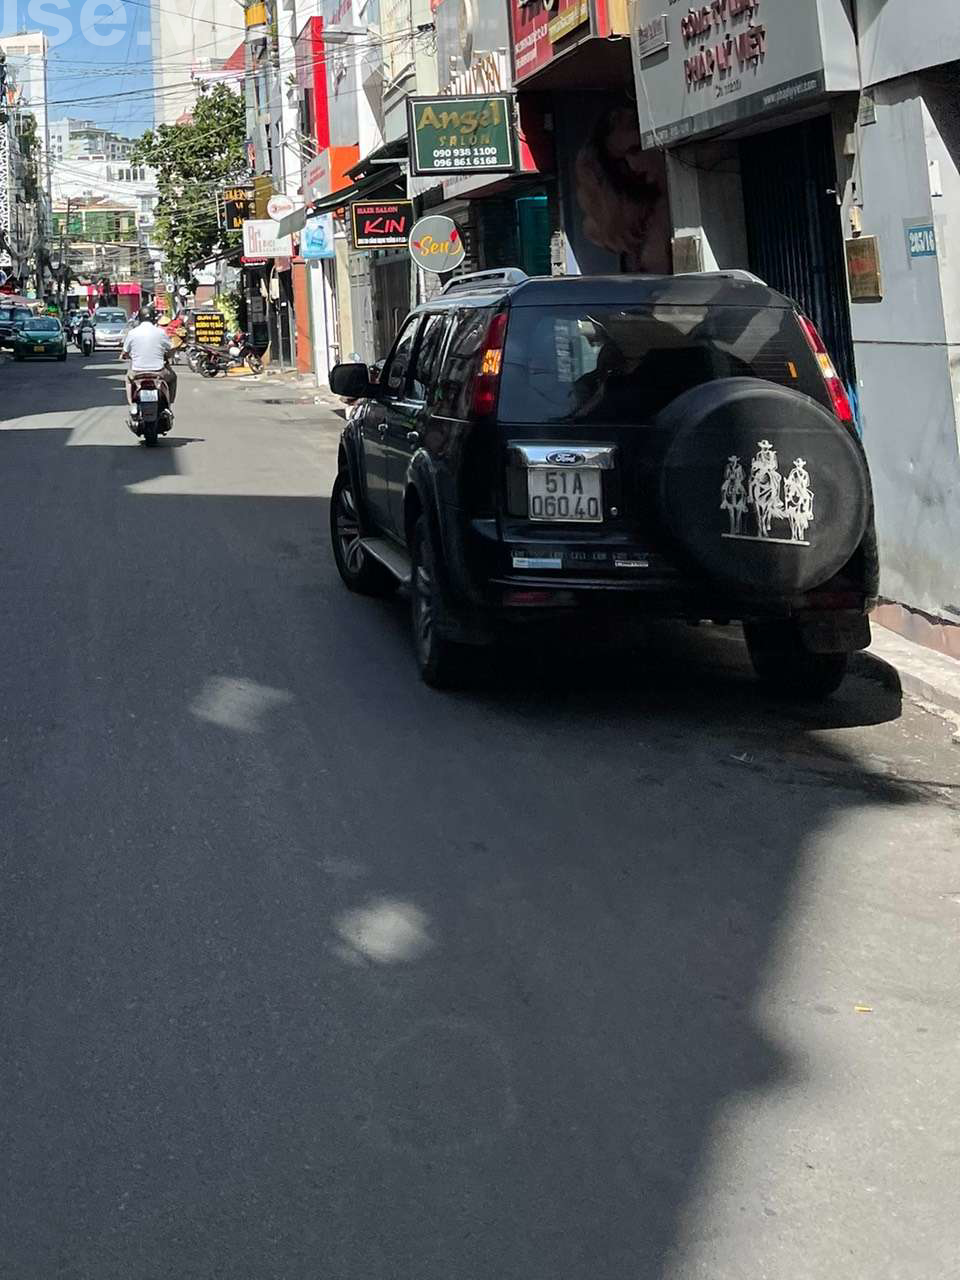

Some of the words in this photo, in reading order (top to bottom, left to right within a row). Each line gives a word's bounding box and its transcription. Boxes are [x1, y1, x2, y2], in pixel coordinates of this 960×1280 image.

[681, 6, 712, 41] CÔNG
[416, 99, 503, 135] Angel
[433, 149, 451, 158] 090
[453, 148, 471, 157] 938
[473, 147, 497, 156] 1100
[434, 159, 452, 167] 096
[454, 158, 471, 166] 861
[473, 157, 497, 165] 6168
[375, 206, 398, 214] SALON
[364, 216, 407, 234] KIN
[555, 454, 577, 463] Ford
[545, 472, 584, 495] 51A
[532, 495, 599, 518] 060.40
